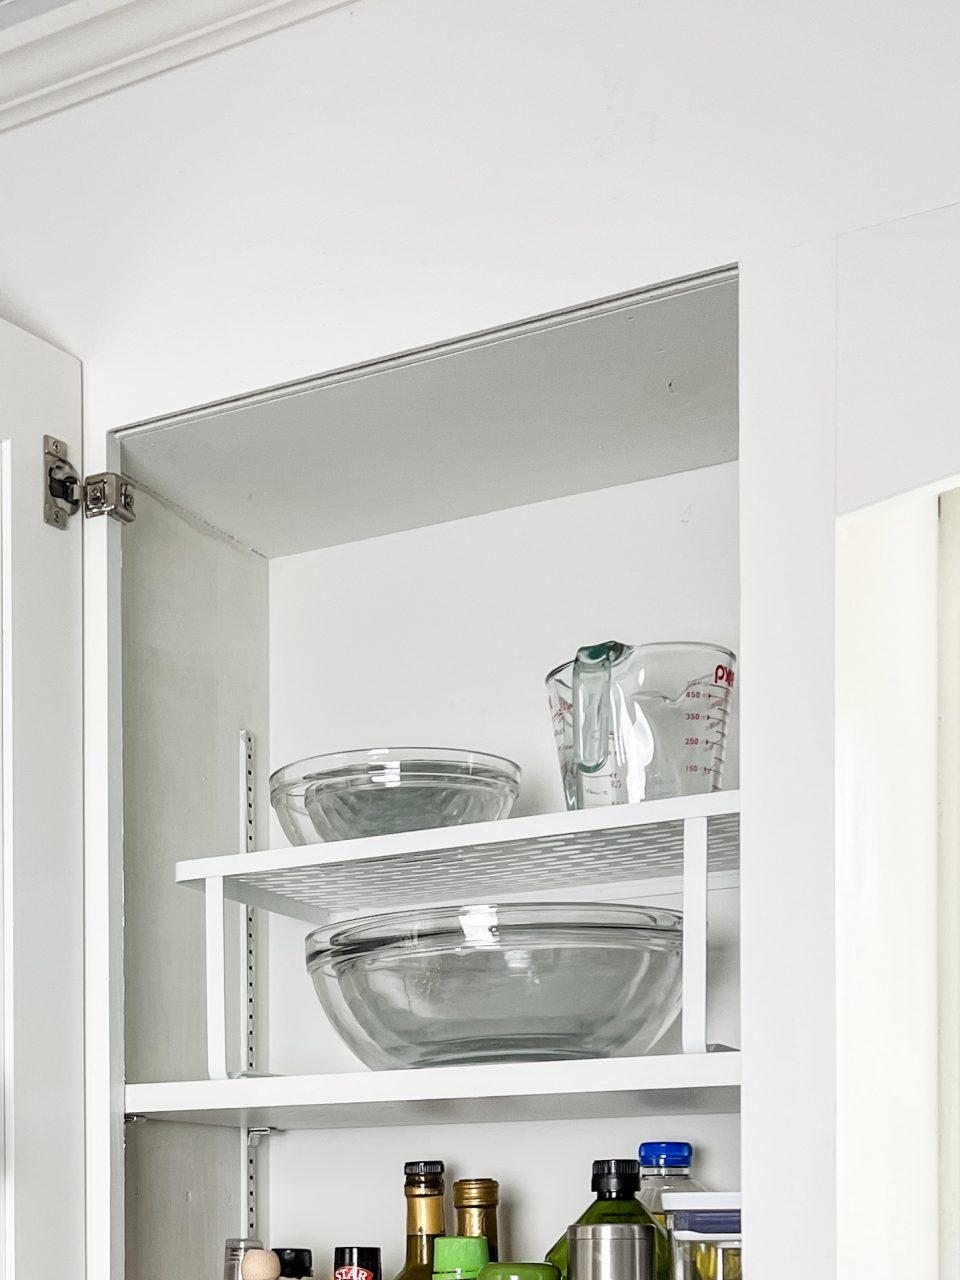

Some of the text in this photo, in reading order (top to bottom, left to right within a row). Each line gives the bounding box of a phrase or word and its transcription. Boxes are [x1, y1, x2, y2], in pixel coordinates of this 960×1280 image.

[685, 691, 701, 699] 450
[685, 712, 700, 720] 350
[684, 738, 699, 746] 250
[686, 765, 698, 773] 150
